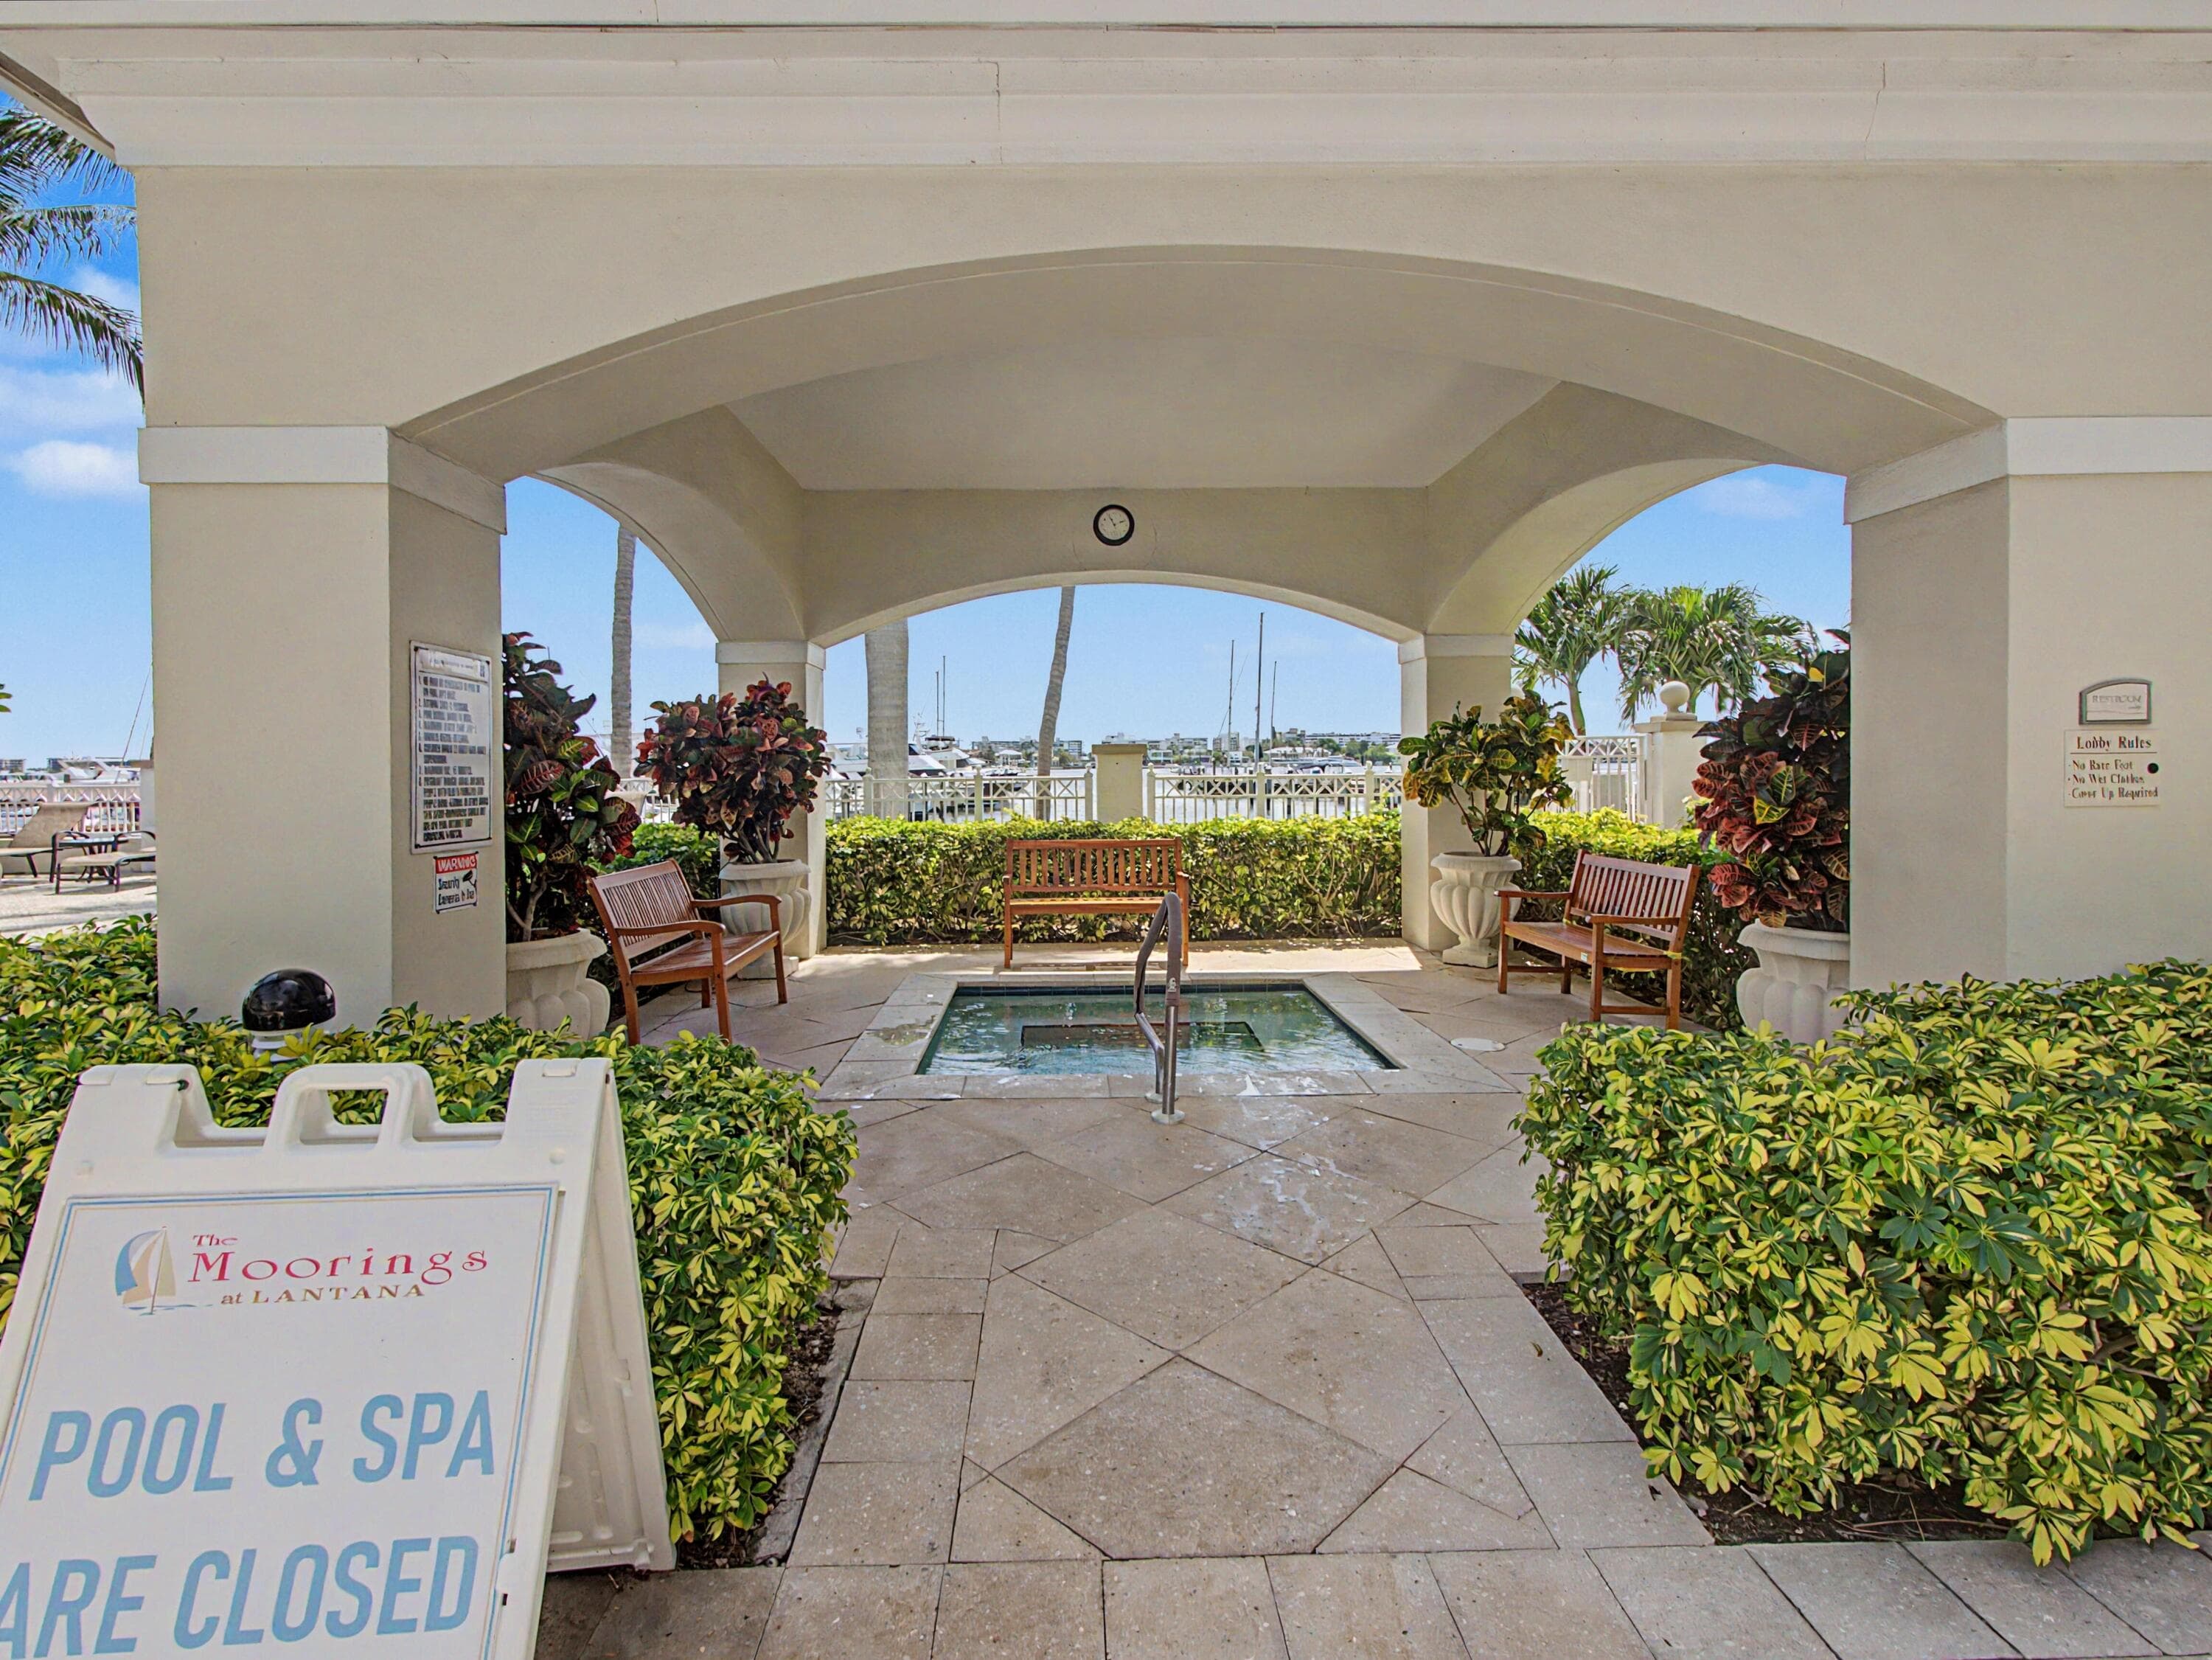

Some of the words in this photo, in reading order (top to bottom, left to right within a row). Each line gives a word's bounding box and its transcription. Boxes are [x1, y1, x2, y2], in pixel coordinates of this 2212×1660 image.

[2077, 736, 2111, 751] Lobby
[2118, 735, 2152, 749] Rules
[2073, 760, 2085, 770] No
[2073, 774, 2085, 784] No
[2089, 774, 2106, 784] Wet
[2111, 774, 2144, 784] Clothes
[2118, 787, 2158, 800] Required
[438, 856, 476, 872] WARNING
[192, 1234, 237, 1247] The
[188, 1248, 487, 1285] Moorings
[220, 1293, 242, 1305] at
[254, 1284, 425, 1304] LANTANA
[29, 1403, 233, 1501] POOL
[265, 1398, 323, 1487] &
[352, 1390, 495, 1483] SPA
[0, 1555, 157, 1659] ARE
[173, 1535, 479, 1650] CLOSED
